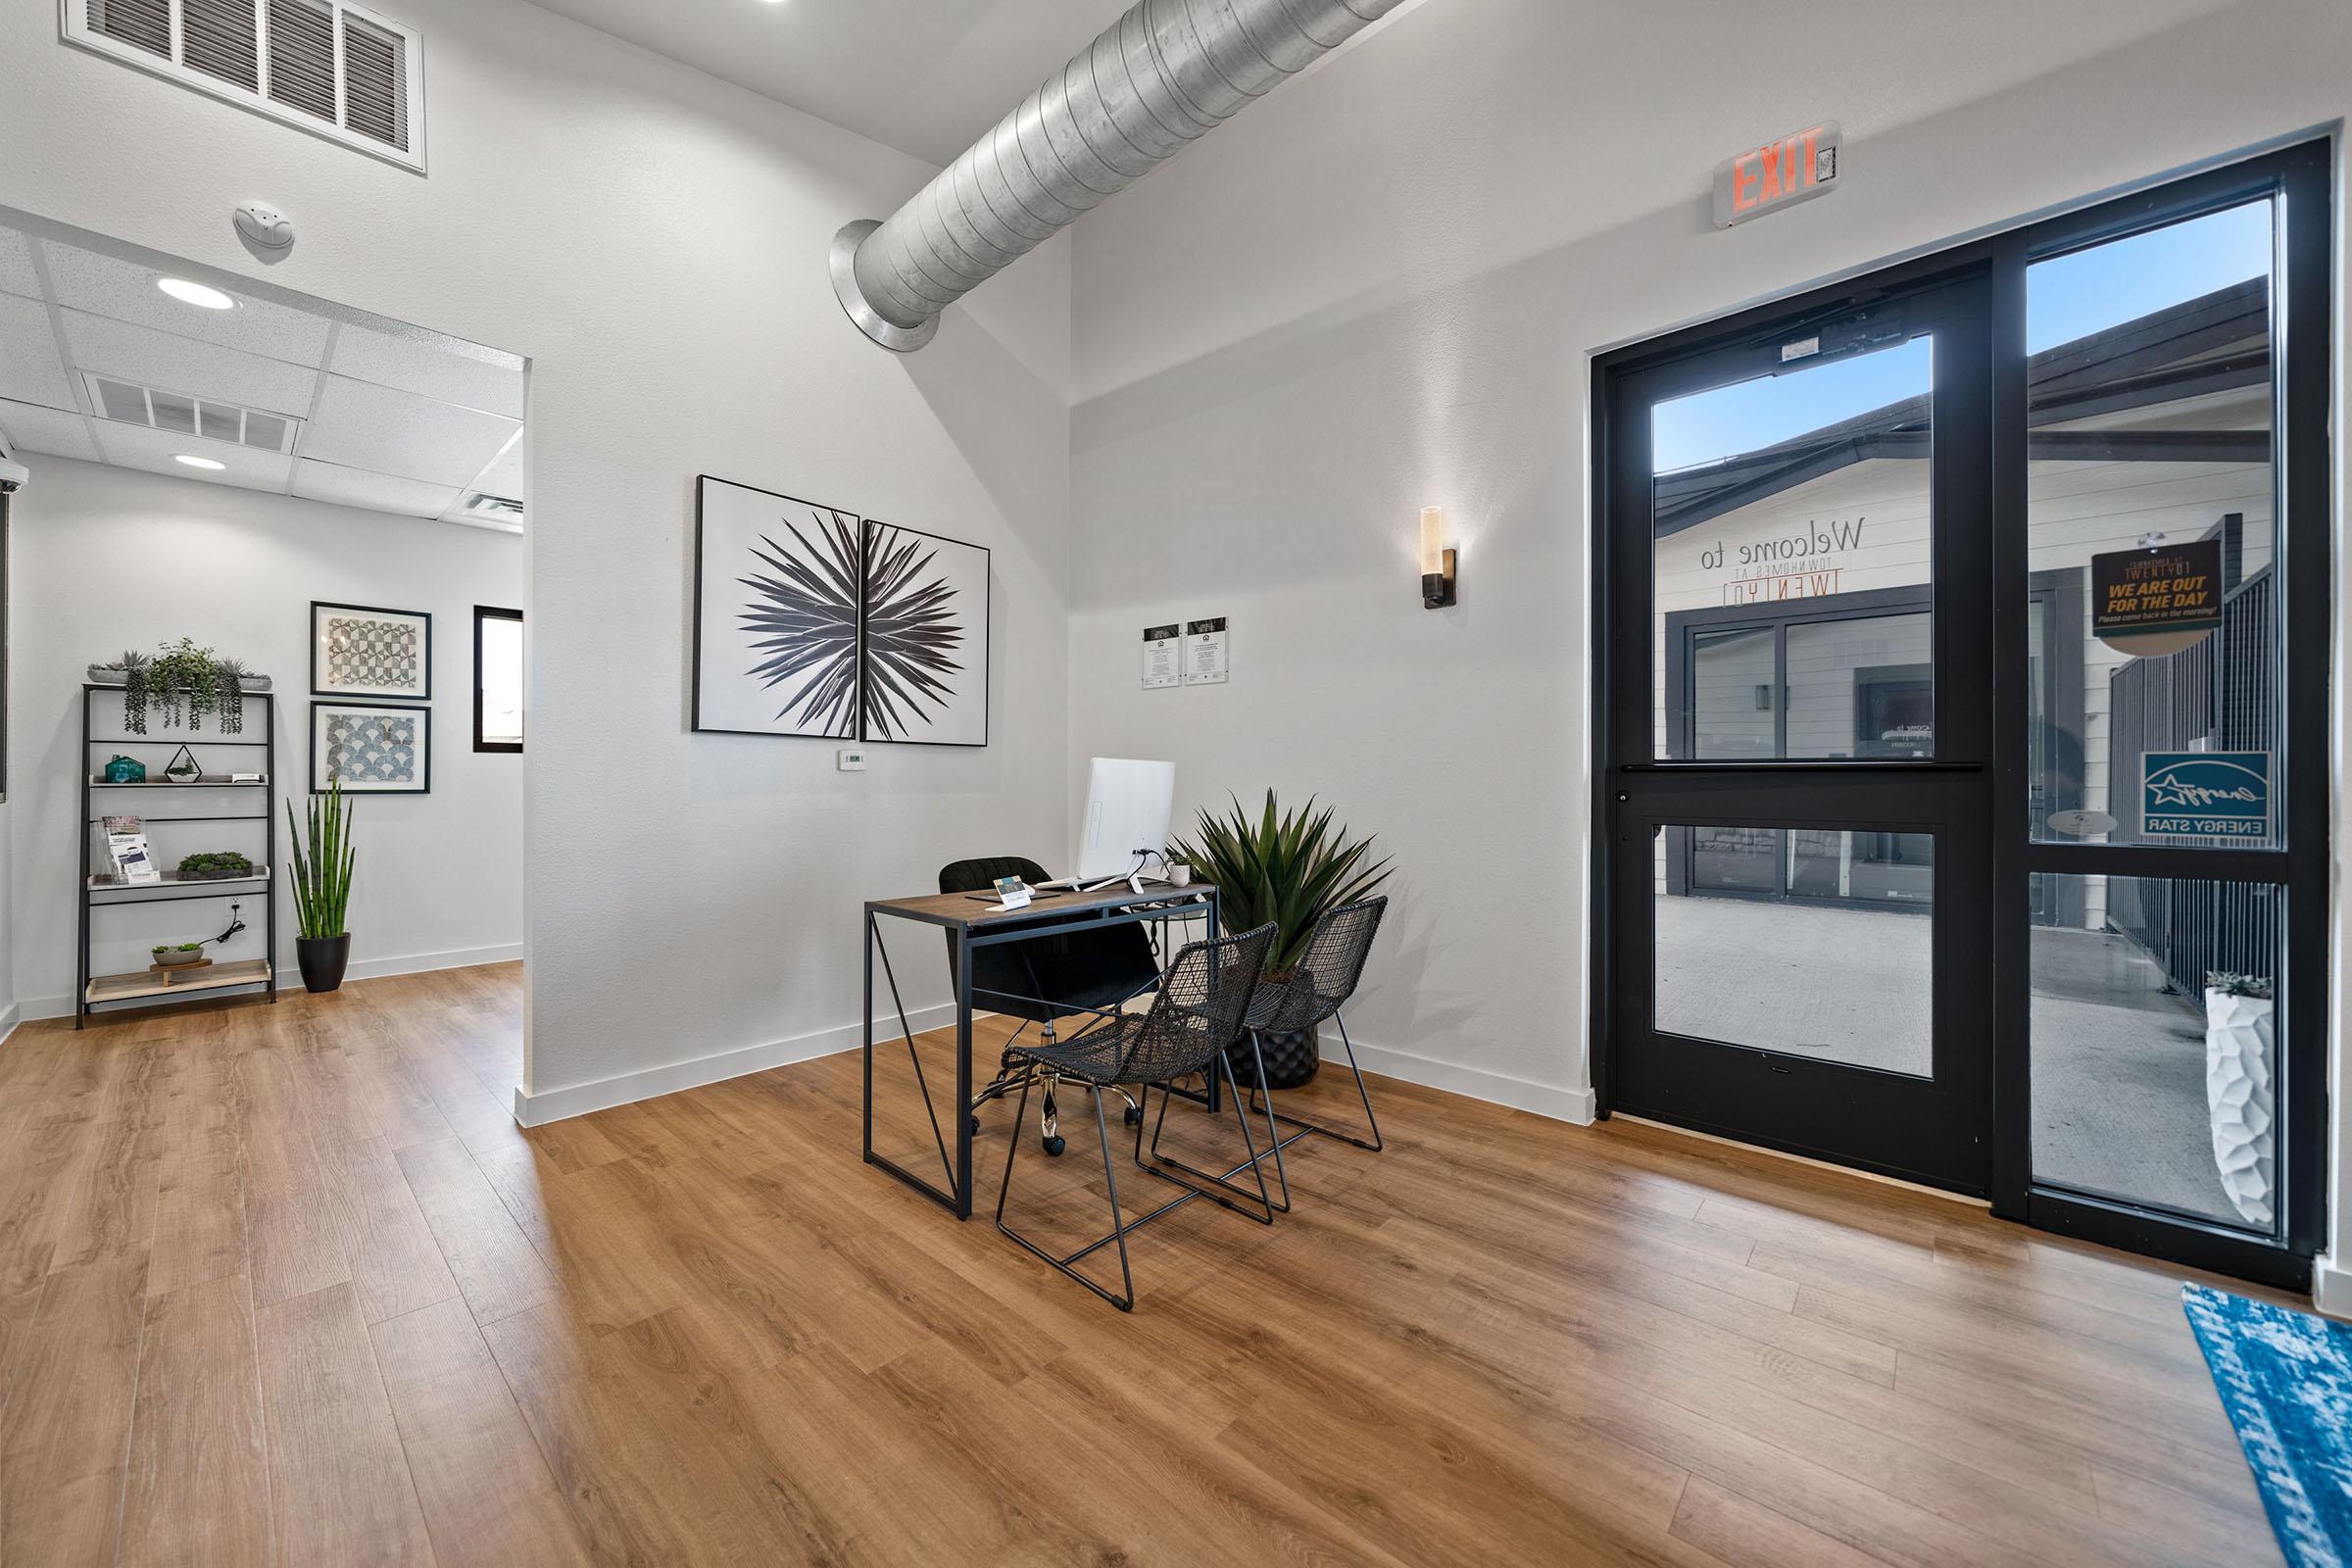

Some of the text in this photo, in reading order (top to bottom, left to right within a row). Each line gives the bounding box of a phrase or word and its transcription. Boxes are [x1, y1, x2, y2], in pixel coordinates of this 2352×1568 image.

[1734, 125, 1823, 214] EXIT
[2109, 576, 2207, 598] WE ARE OUT
[2107, 591, 2208, 613] FOR THE DAY
